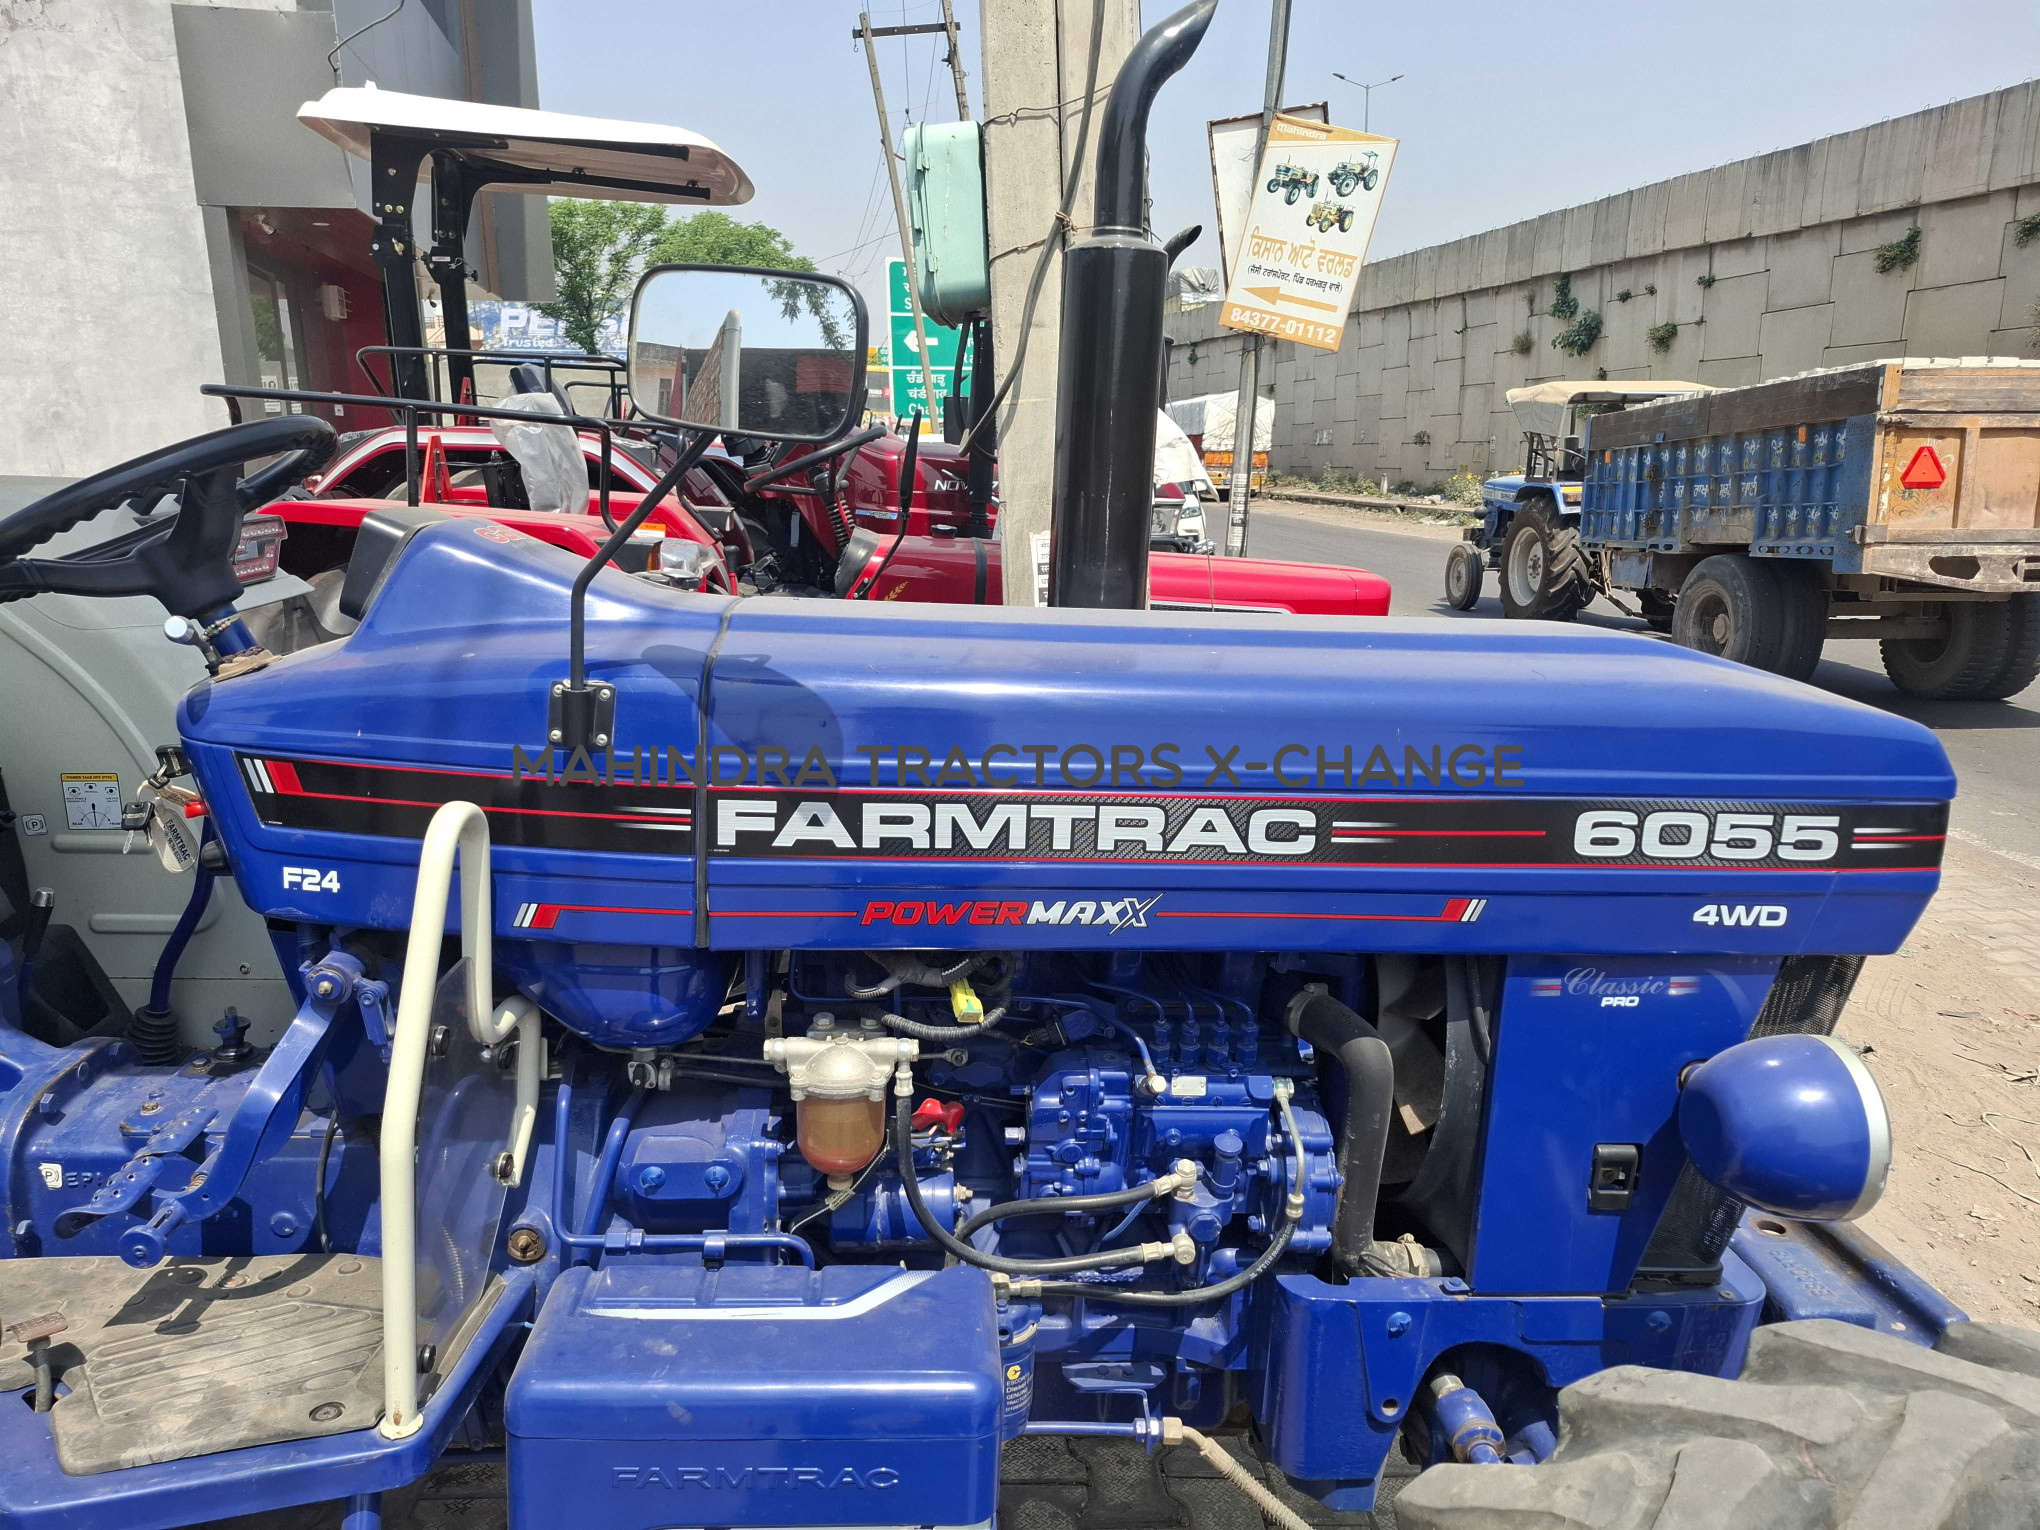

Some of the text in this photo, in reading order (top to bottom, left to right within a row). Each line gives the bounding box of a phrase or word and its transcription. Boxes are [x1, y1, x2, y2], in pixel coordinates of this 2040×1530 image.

[1317, 248, 1358, 278] ਵਰਲਡ
[1230, 307, 1337, 344] 84377-01112
[502, 337, 554, 349] Trusted
[165, 819, 192, 861] FARMTRAC
[717, 799, 1317, 855] FARMTRAC
[1573, 810, 1841, 861] 6055
[283, 866, 340, 893] F24
[1692, 904, 1788, 927] 4WD
[1564, 966, 1670, 996] Classic
[1600, 995, 1640, 1008] PRO
[611, 1467, 900, 1489] FARMTRAC
